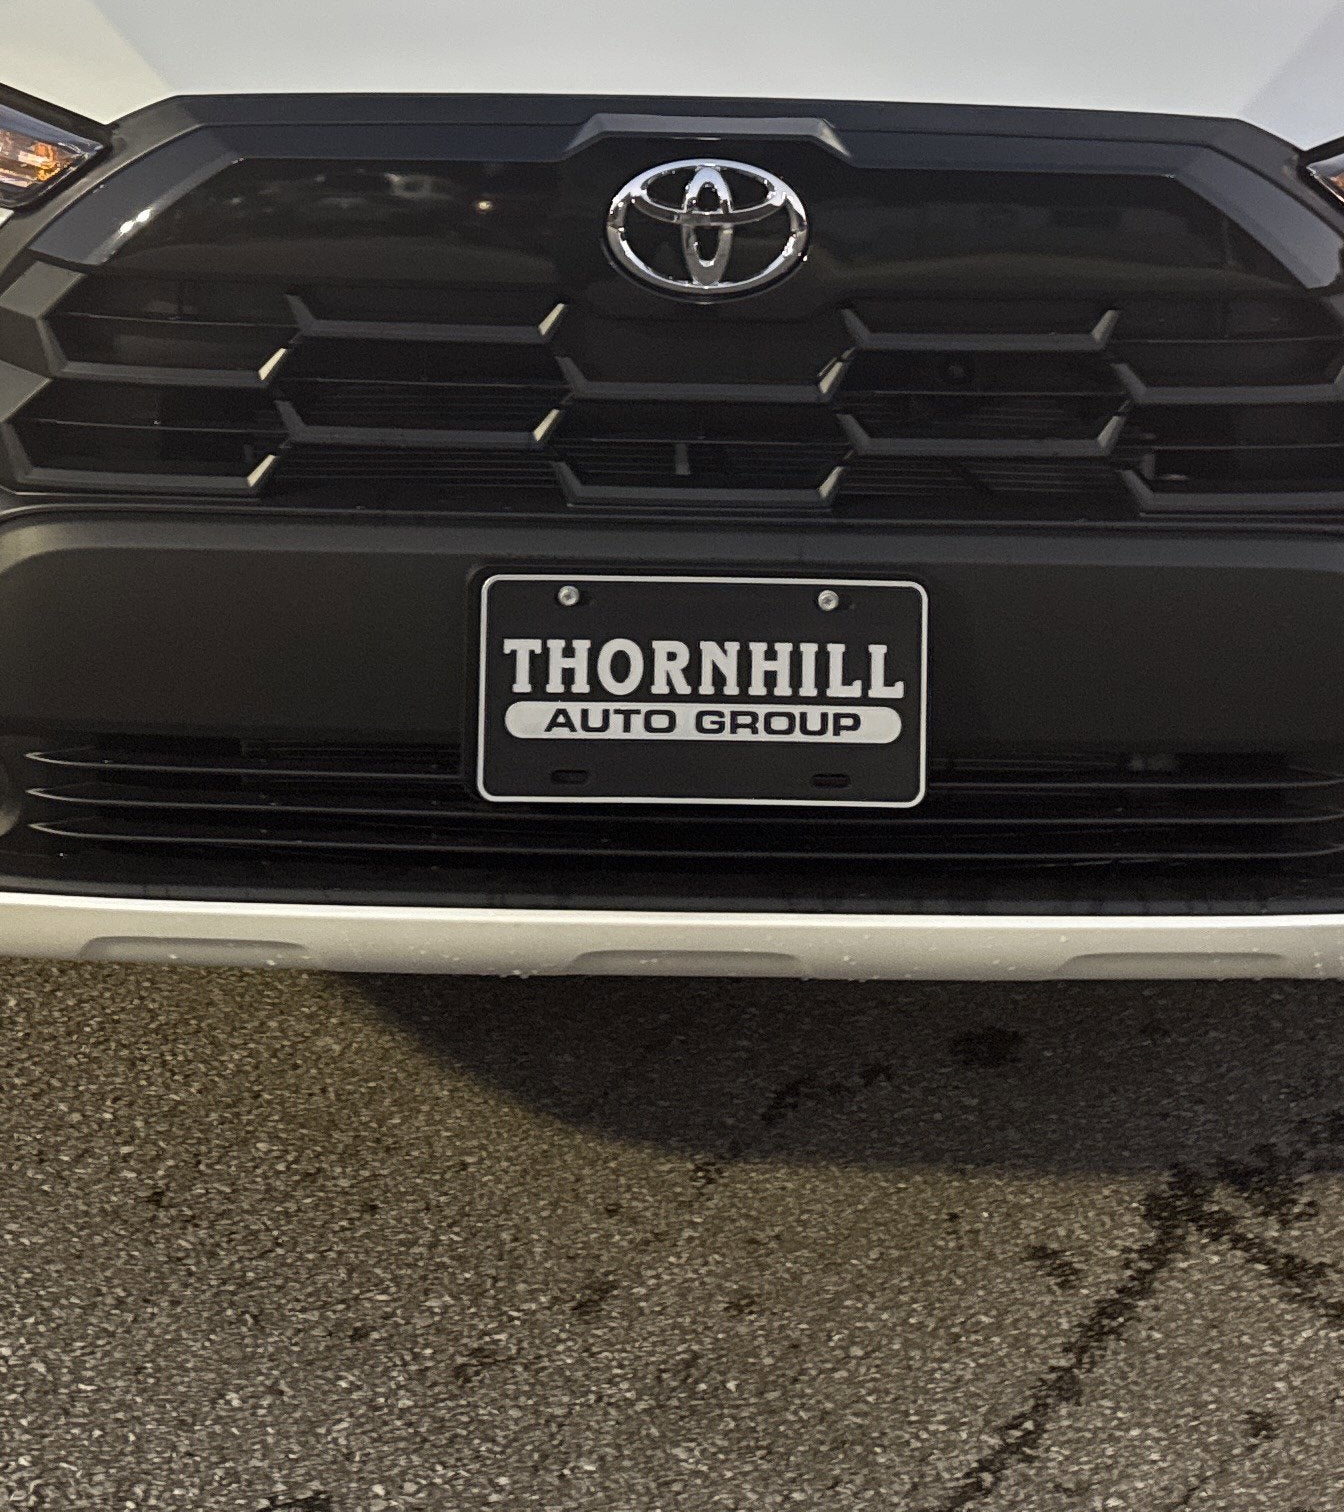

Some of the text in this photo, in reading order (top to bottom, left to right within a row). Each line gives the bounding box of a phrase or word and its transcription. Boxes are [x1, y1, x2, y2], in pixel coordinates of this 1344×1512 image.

[503, 638, 905, 699] THORNHILL
[544, 708, 861, 737] AUTO GROUP
